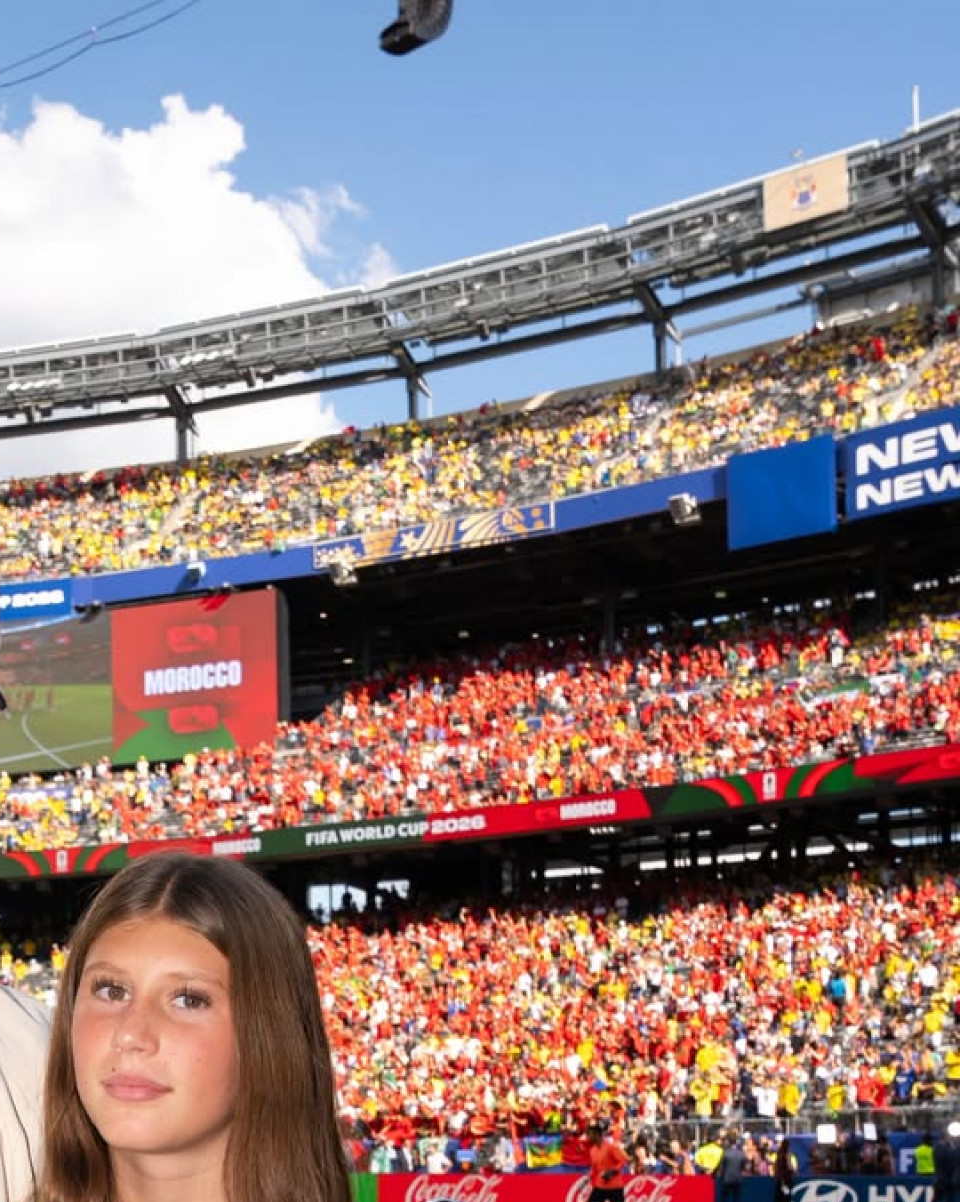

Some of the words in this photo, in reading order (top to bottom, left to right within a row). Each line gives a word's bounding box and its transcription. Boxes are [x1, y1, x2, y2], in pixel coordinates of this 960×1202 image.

[144, 660, 242, 696] MOROCCO
[305, 829, 339, 847] FIFA
[340, 824, 396, 843] WORLD
[398, 821, 429, 838] CUP
[431, 815, 487, 834] 2026
